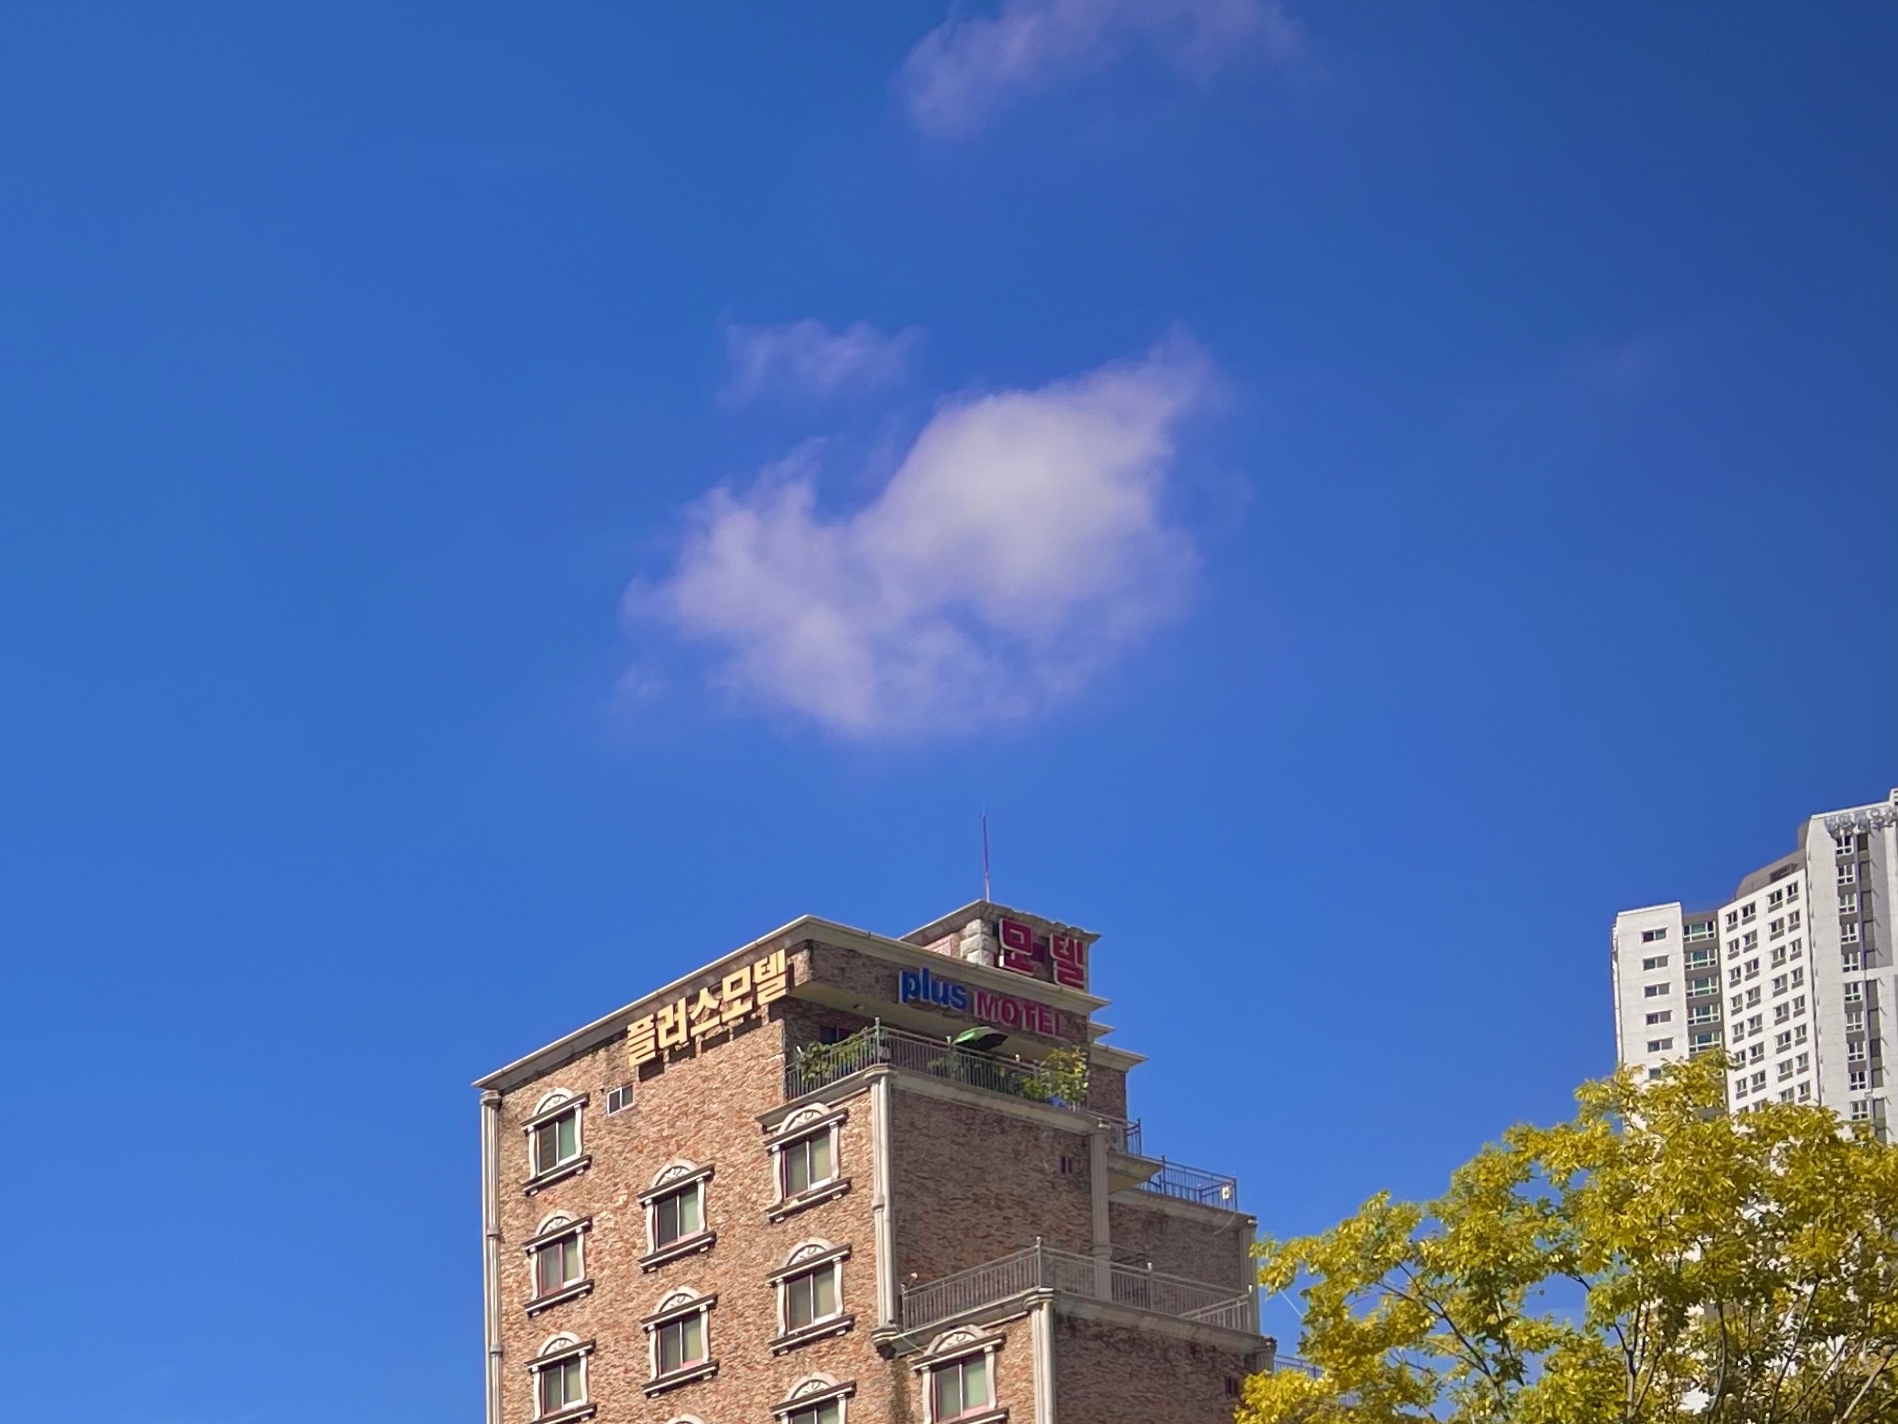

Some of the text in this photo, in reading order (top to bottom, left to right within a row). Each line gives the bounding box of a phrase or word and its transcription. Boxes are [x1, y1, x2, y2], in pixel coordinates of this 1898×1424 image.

[1000, 918, 1086, 991] 모텔
[627, 949, 789, 1067] 플러스모텔
[899, 967, 1063, 1038] plus MOTEL
